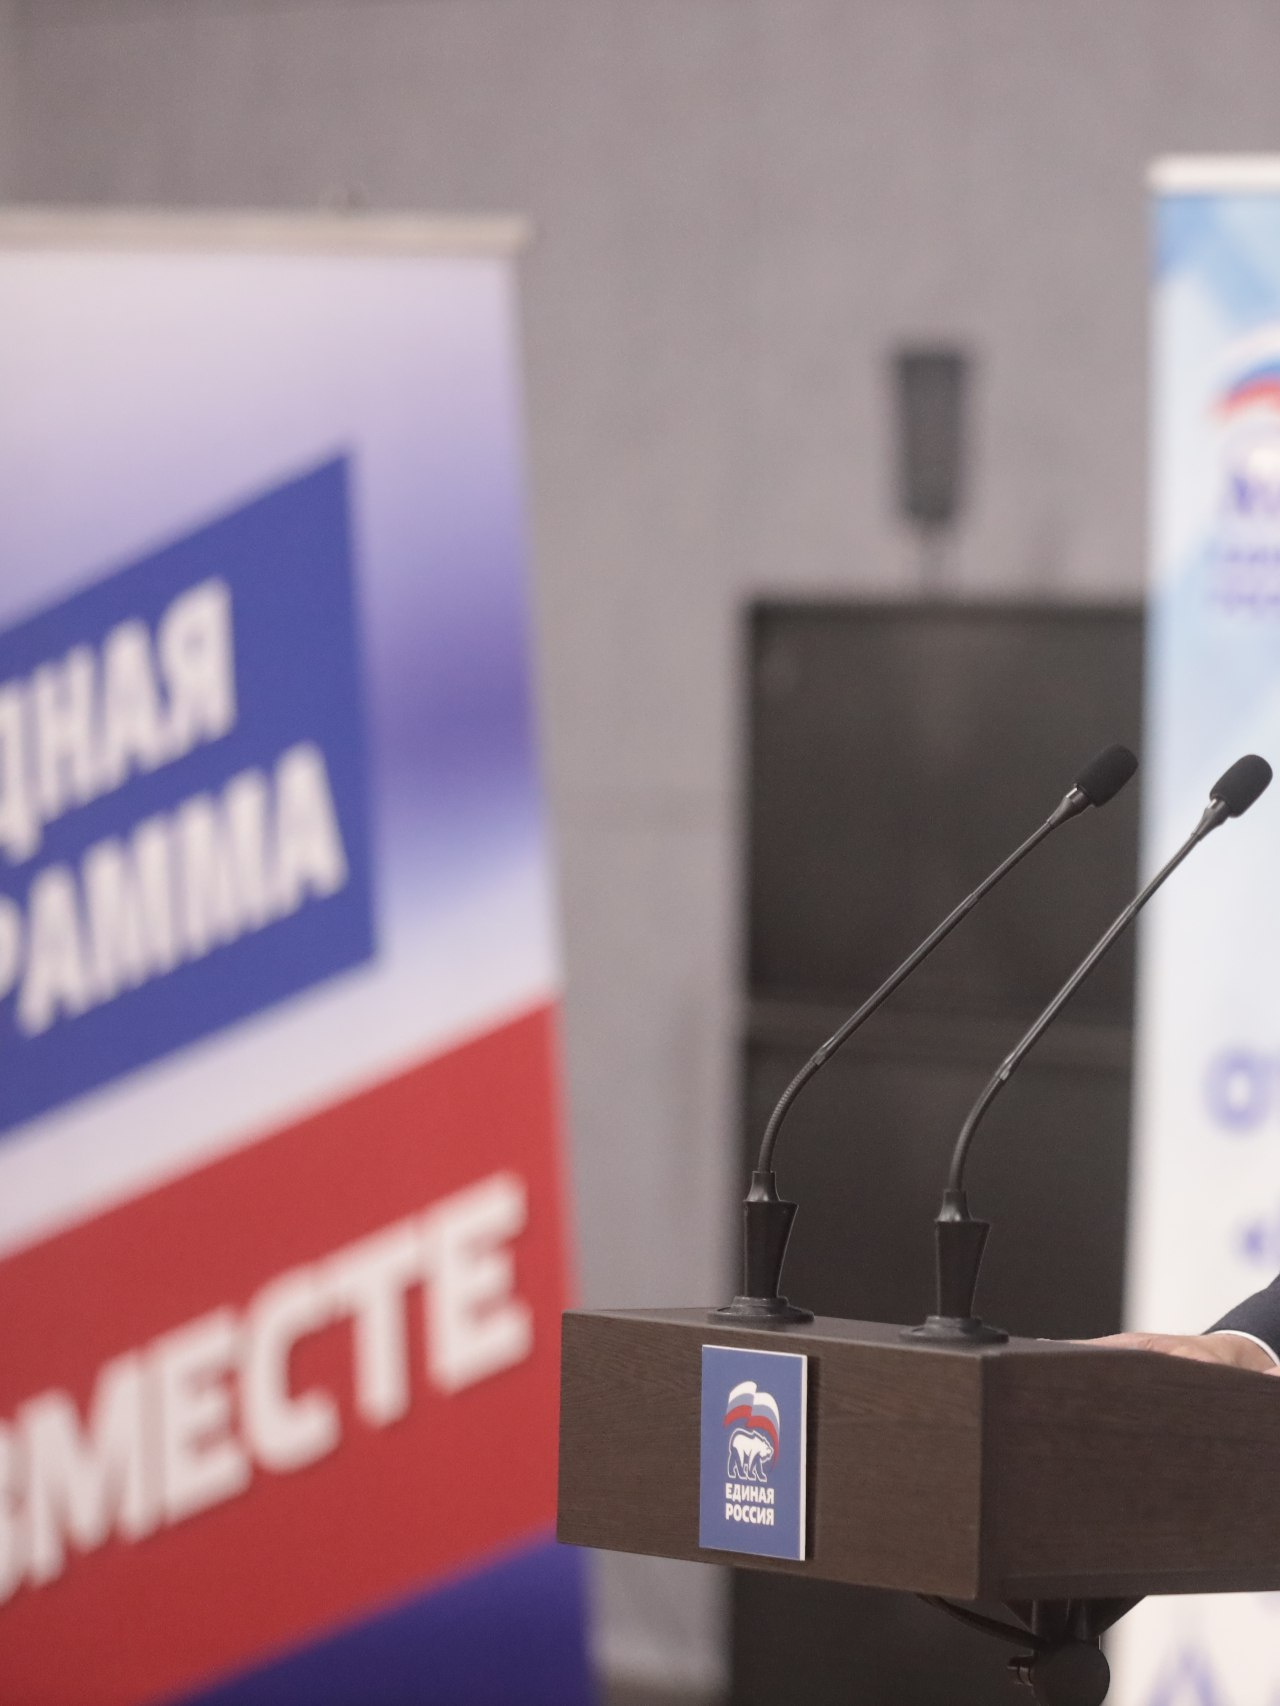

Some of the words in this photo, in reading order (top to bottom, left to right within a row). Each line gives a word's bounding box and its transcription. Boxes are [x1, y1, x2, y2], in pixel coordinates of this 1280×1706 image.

[0, 1168, 534, 1606] МЕСТЕ
[725, 1482, 775, 1504] ЕДИНАЯ
[725, 1502, 775, 1526] РОССИЯ
